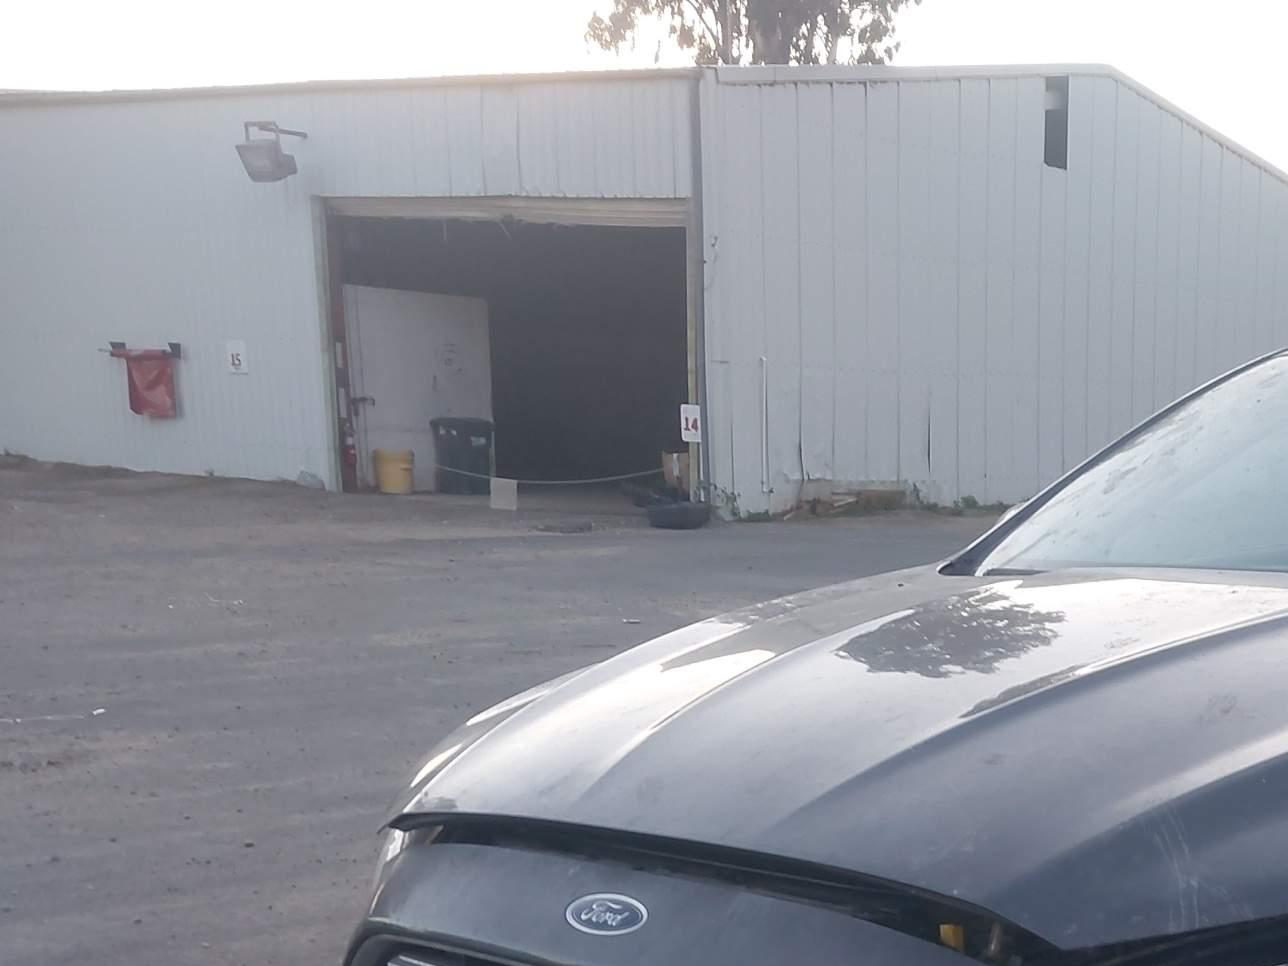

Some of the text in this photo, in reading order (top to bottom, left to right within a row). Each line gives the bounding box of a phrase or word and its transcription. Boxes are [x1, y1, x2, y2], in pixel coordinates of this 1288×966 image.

[230, 352, 242, 367] 15
[683, 416, 699, 433] 14
[580, 900, 630, 927] Ford
